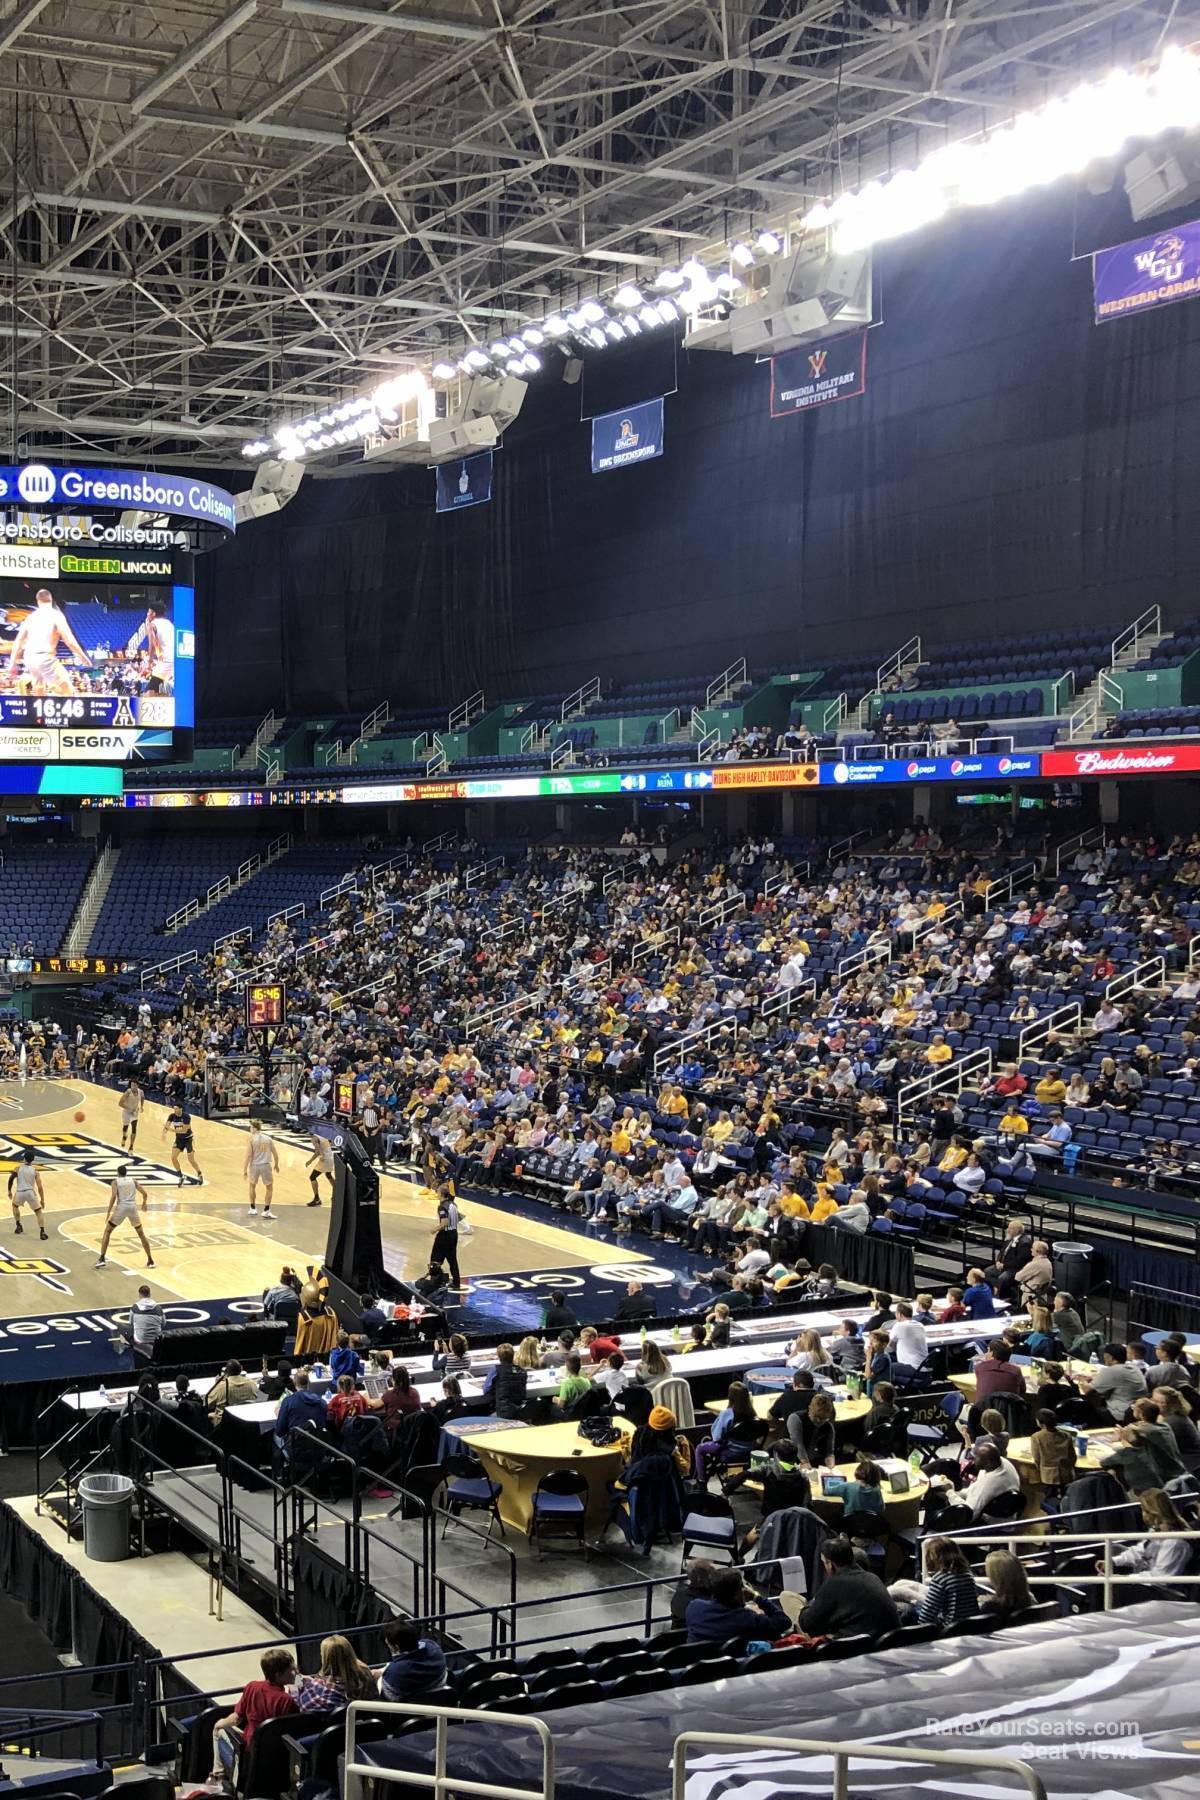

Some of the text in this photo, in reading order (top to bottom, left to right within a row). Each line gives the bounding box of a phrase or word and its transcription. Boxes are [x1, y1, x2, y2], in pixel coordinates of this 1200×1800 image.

[1135, 251, 1183, 282] WCU
[1099, 290, 1158, 314] WESTERN
[781, 372, 855, 401] VIRGINIA MILITARY
[796, 388, 838, 407] INSTITUTE
[600, 458, 613, 468] UNC
[61, 472, 184, 507] Greensboro
[188, 486, 233, 519] Coliseum
[89, 523, 175, 545] Coliseum
[61, 555, 172, 575] GREEN LINCOLN
[33, 699, 85, 718] 16:46
[140, 702, 168, 723] 28
[62, 736, 125, 748] SEGRA
[849, 764, 884, 774] Greensboro
[919, 760, 1031, 775] pepsi pepsi pepsi
[1075, 751, 1176, 773] Budweiser
[714, 773, 731, 785] RIDING
[733, 772, 745, 784] HIGH
[227, 795, 241, 806] 28
[252, 988, 280, 1000] 16:46
[255, 1001, 277, 1022] 21
[101, 1227, 256, 1254] SOCON
